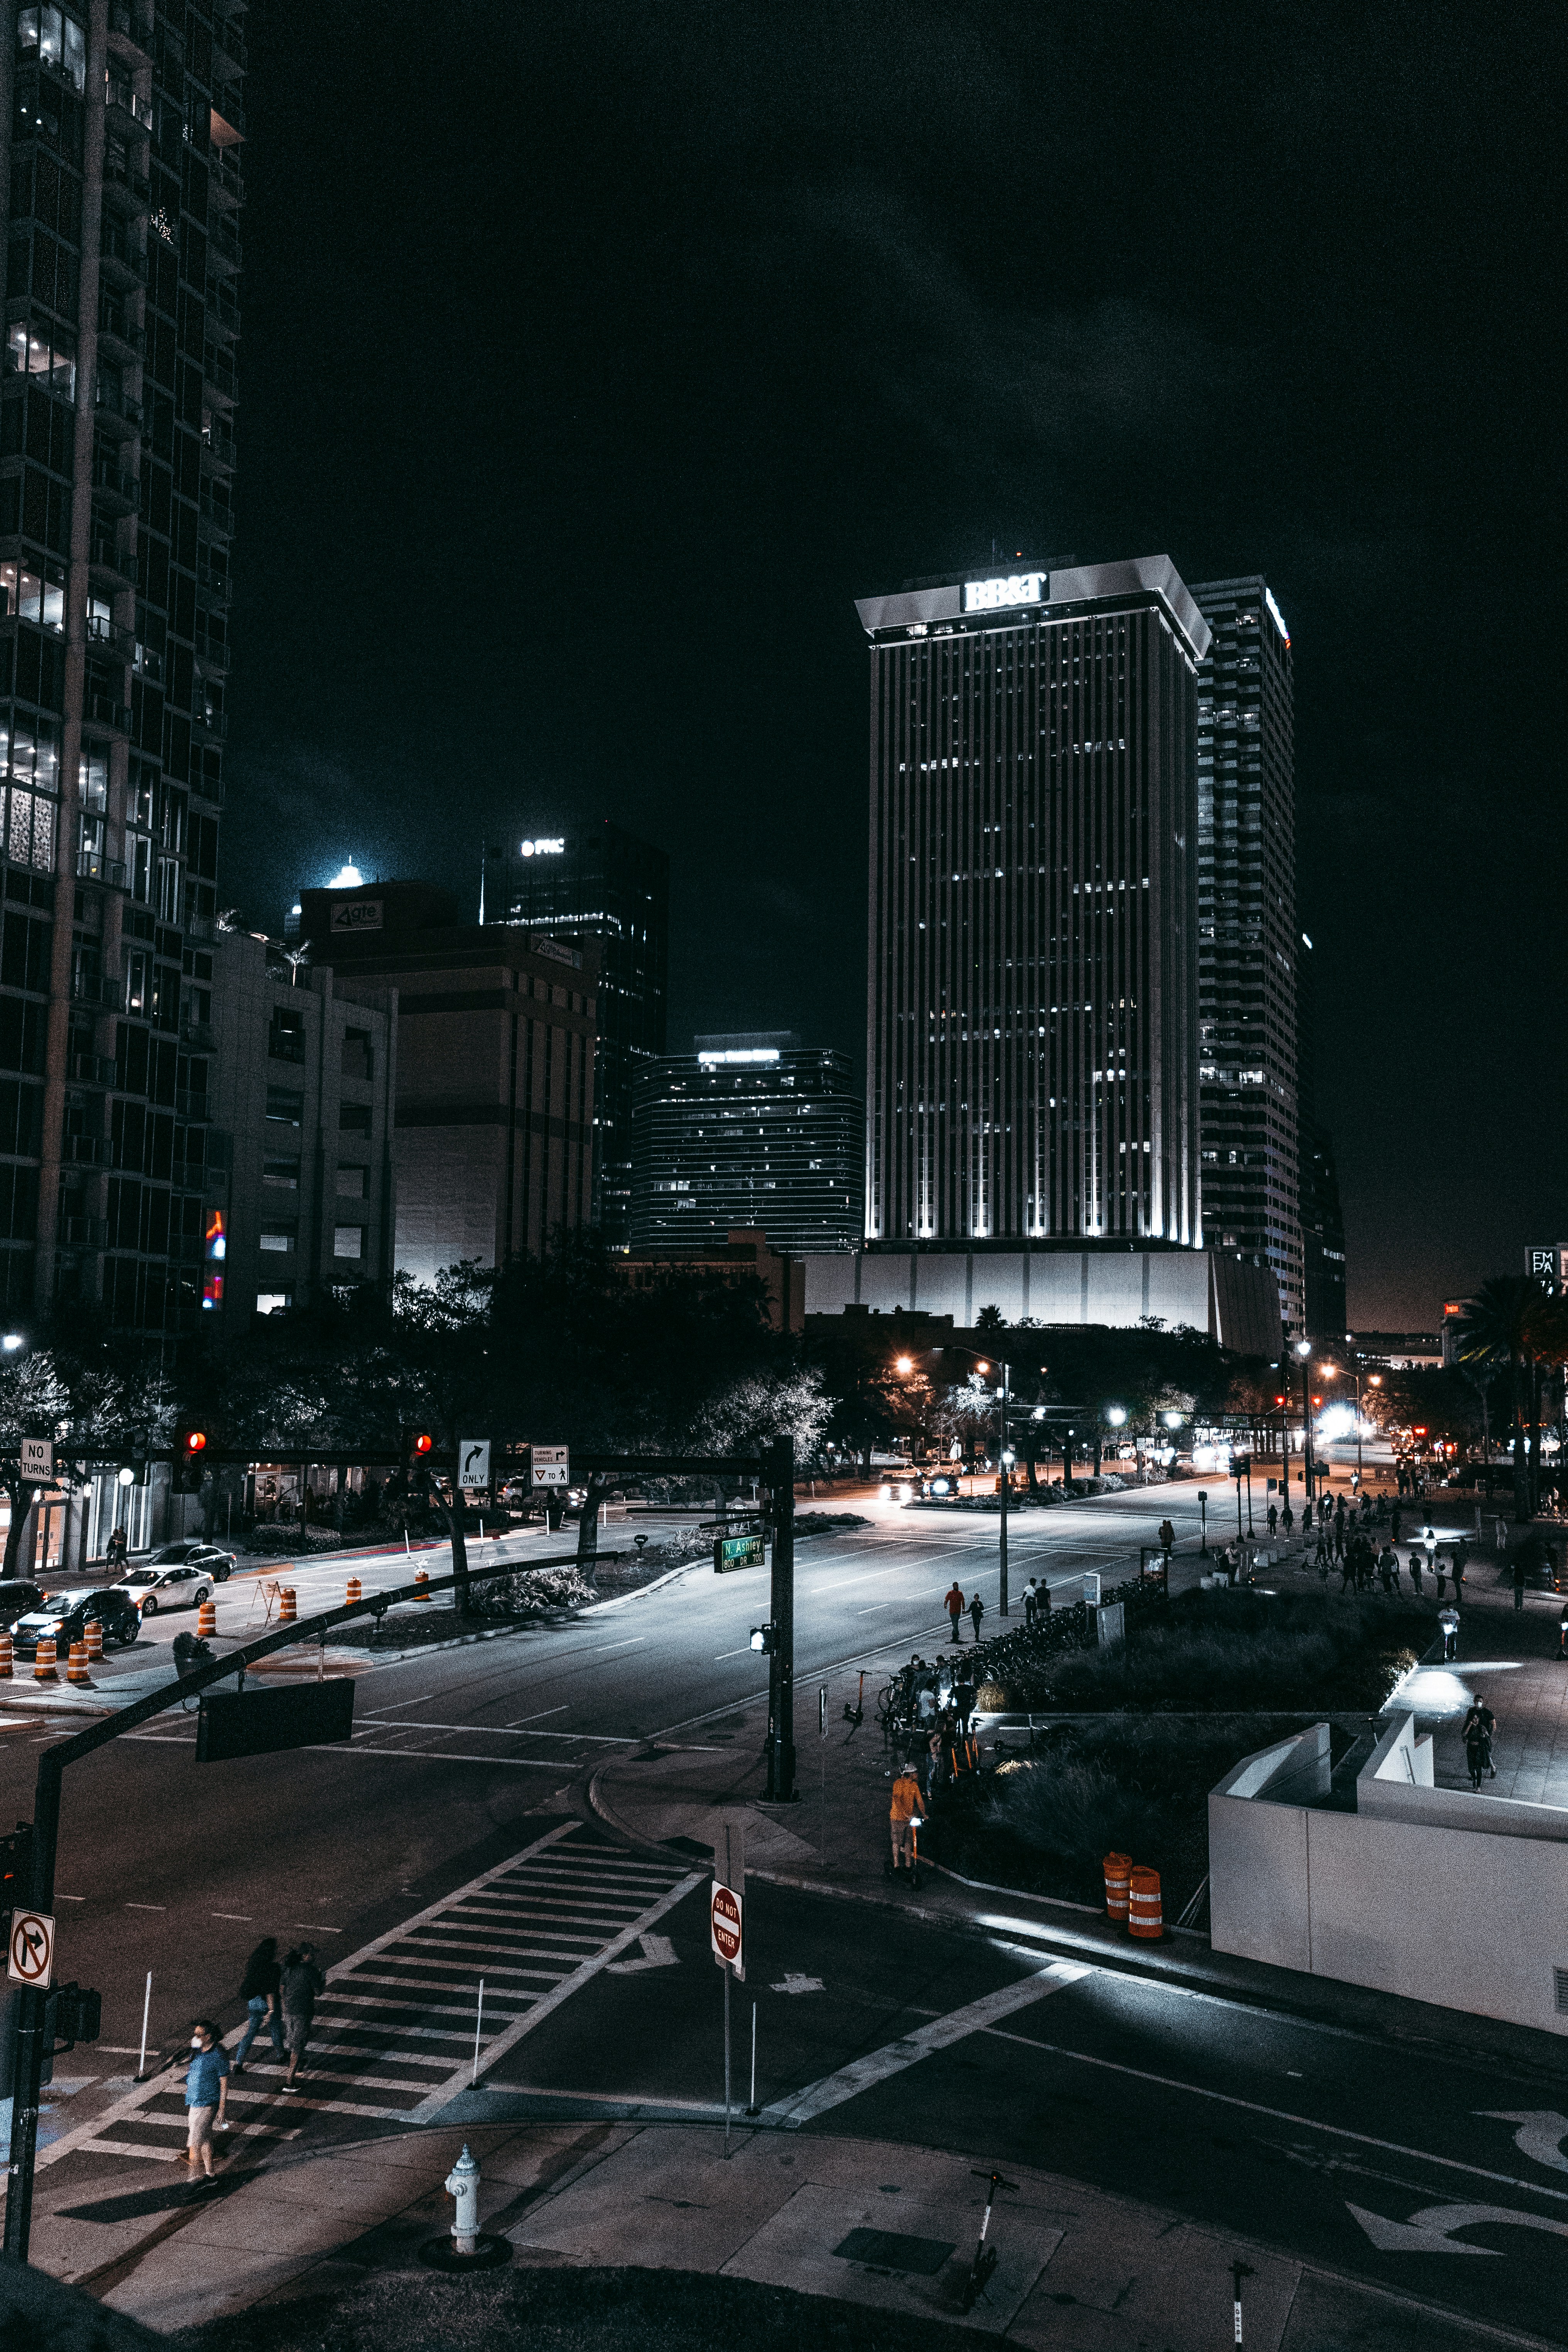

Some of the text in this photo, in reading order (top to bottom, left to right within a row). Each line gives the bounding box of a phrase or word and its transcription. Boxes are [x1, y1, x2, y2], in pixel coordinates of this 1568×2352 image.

[965, 573, 1047, 611] BB&T
[535, 838, 564, 854] PNC
[29, 1445, 43, 1458] NO
[23, 1462, 50, 1475] TURNS
[463, 1475, 484, 1484] ONLY
[725, 1539, 760, 1555] N. Ashley
[724, 1553, 762, 1569] 800 DR 700
[716, 1897, 737, 1918] DO NOT
[718, 1929, 735, 1949] ENTER
